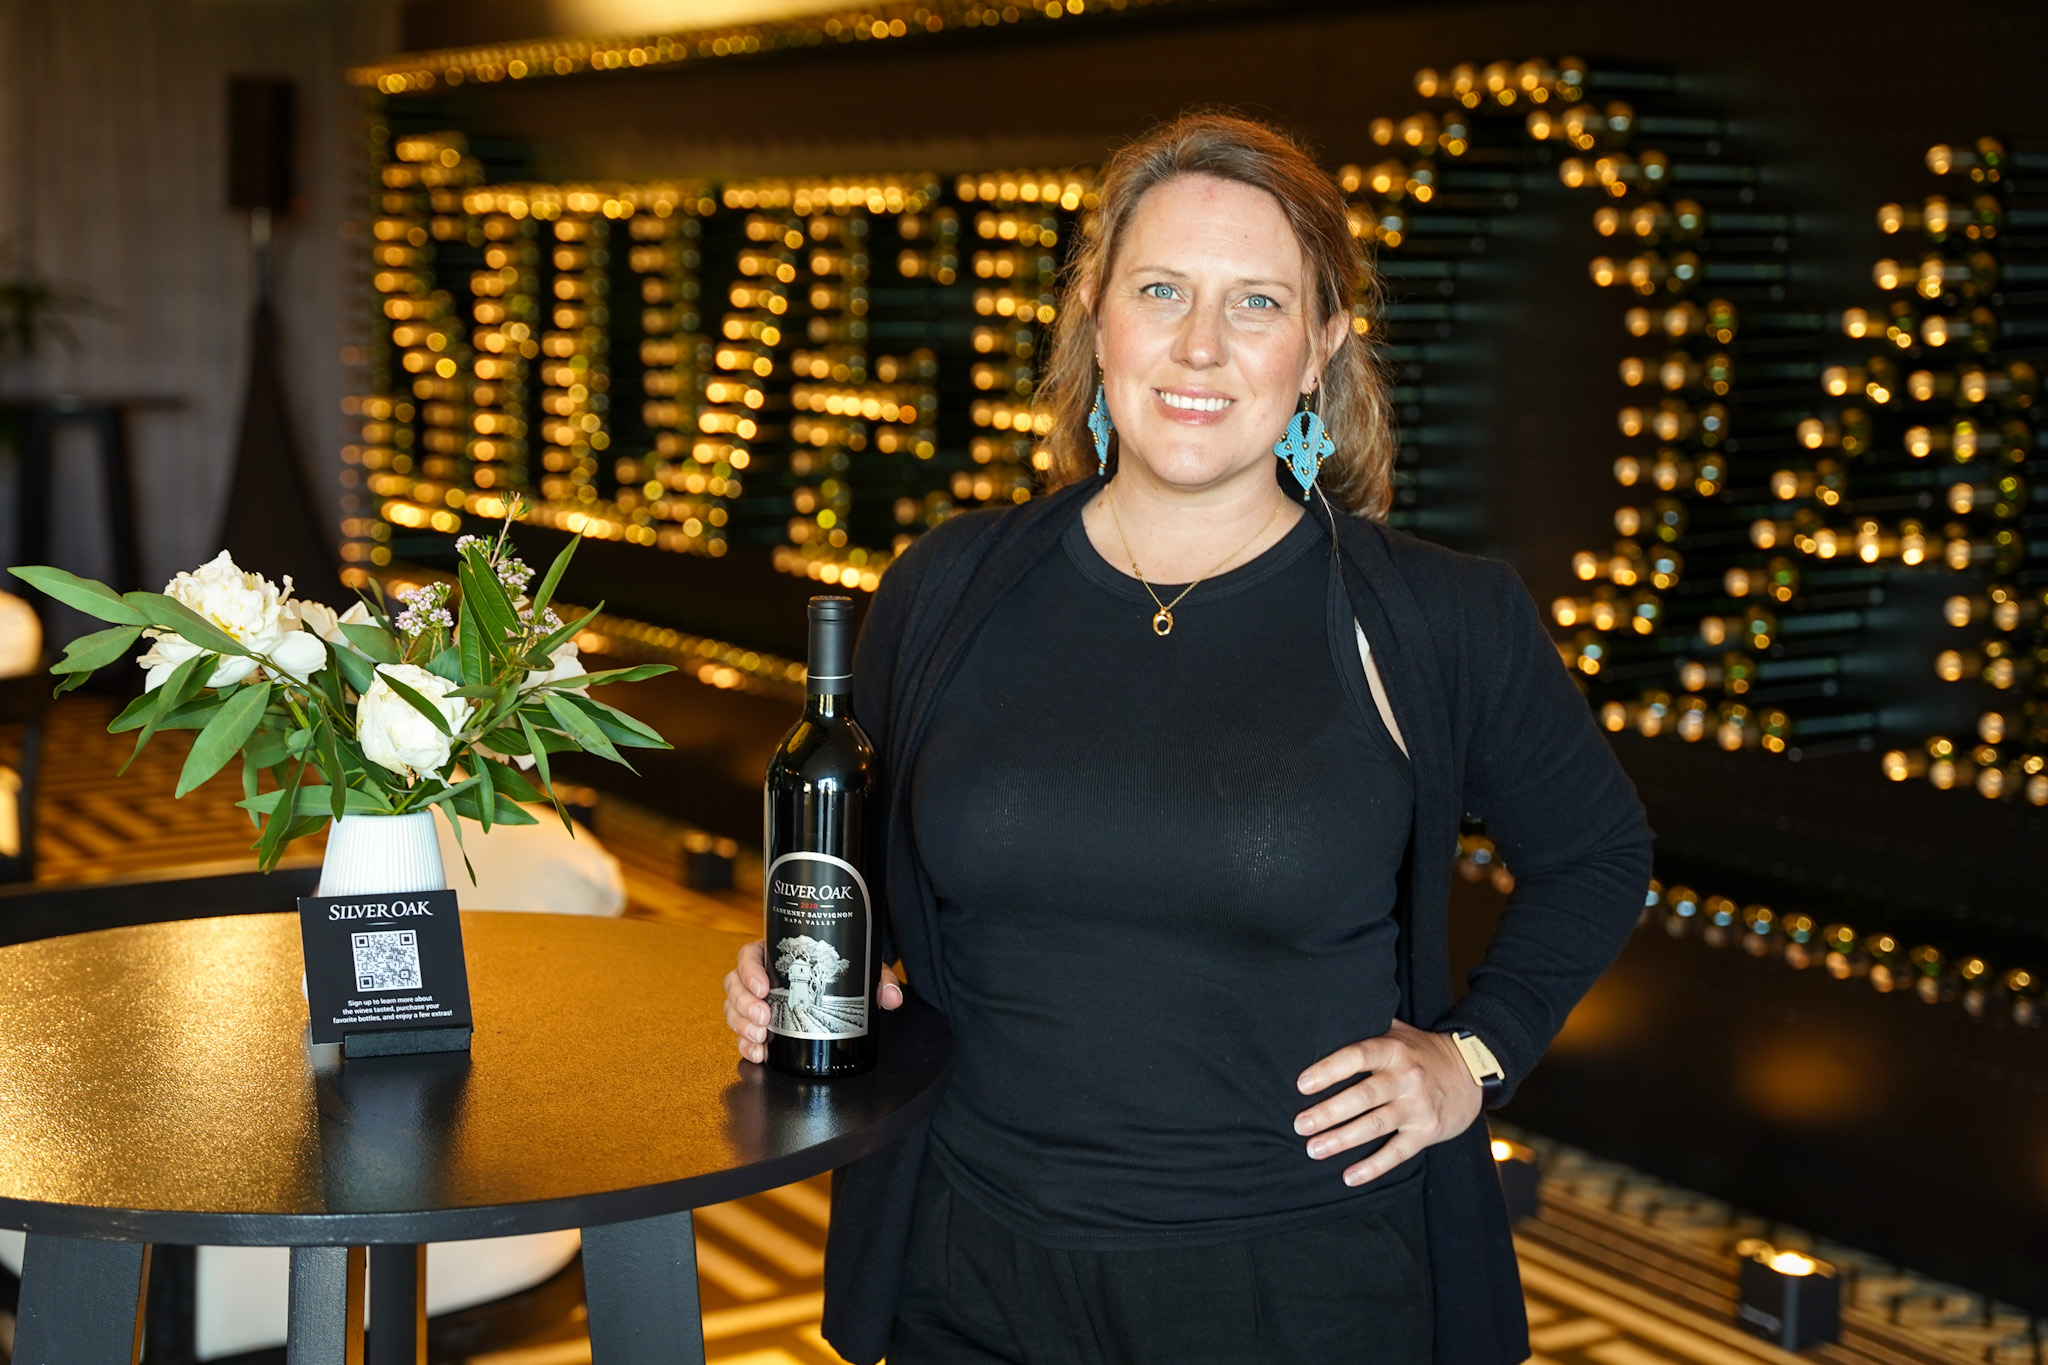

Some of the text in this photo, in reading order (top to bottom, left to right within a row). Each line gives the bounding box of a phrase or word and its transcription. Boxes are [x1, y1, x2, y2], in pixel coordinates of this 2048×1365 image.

[774, 880, 854, 900] SILVER OAK
[328, 900, 434, 920] SILVER OAK
[772, 906, 806, 918] CABERNET
[373, 1005, 395, 1013] tasted,
[396, 1004, 425, 1012] purchase
[332, 1016, 357, 1024] favorite
[395, 1012, 413, 1020] enjoy
[431, 1009, 453, 1017] extras!
